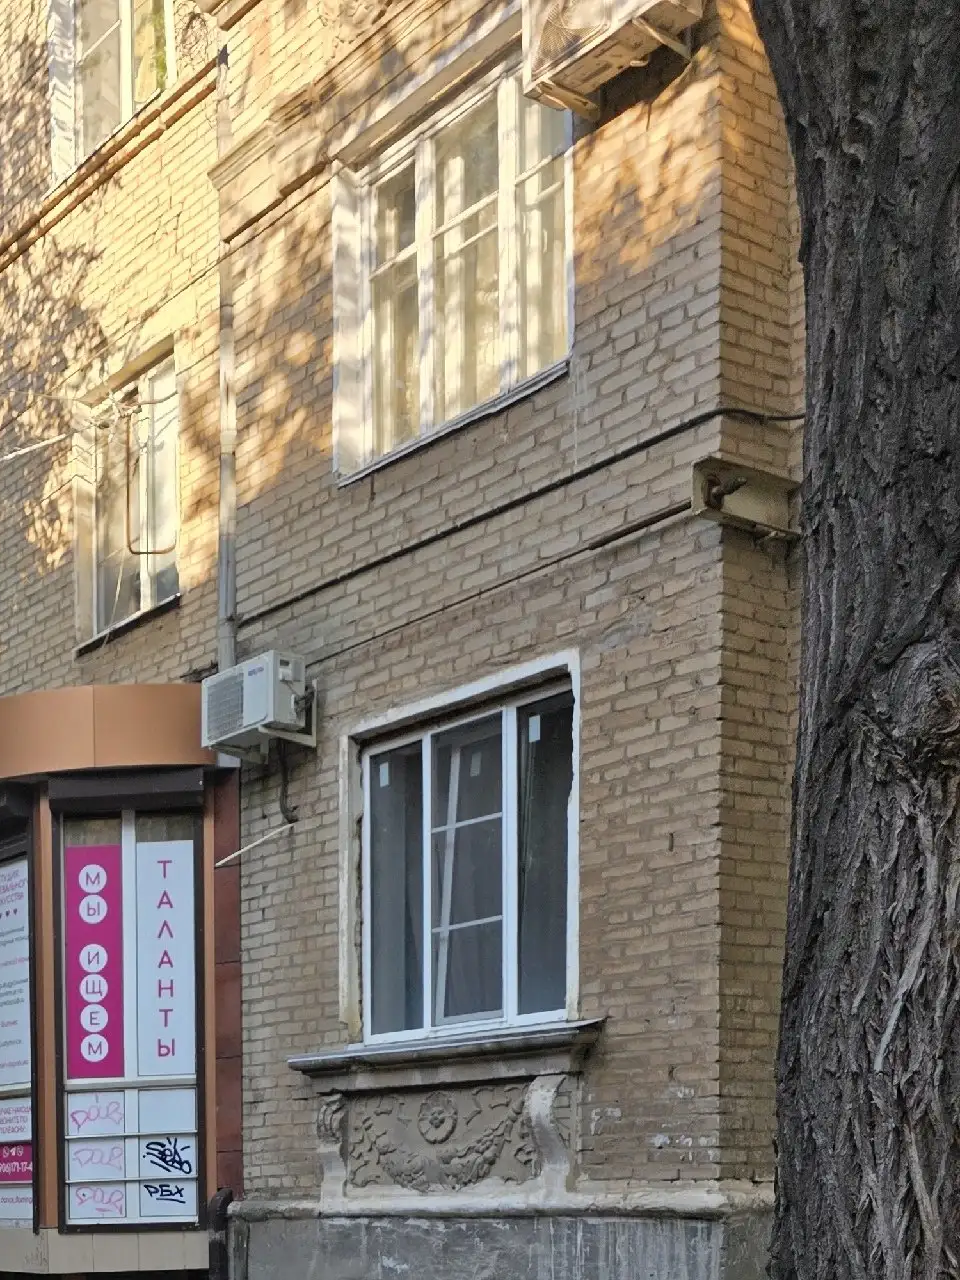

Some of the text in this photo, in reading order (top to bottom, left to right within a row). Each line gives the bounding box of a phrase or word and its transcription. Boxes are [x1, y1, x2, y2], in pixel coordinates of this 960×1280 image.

[85, 871, 103, 1056] МЫ ИЩЕМ
[157, 860, 176, 1057] ТАЛАНТЫ
